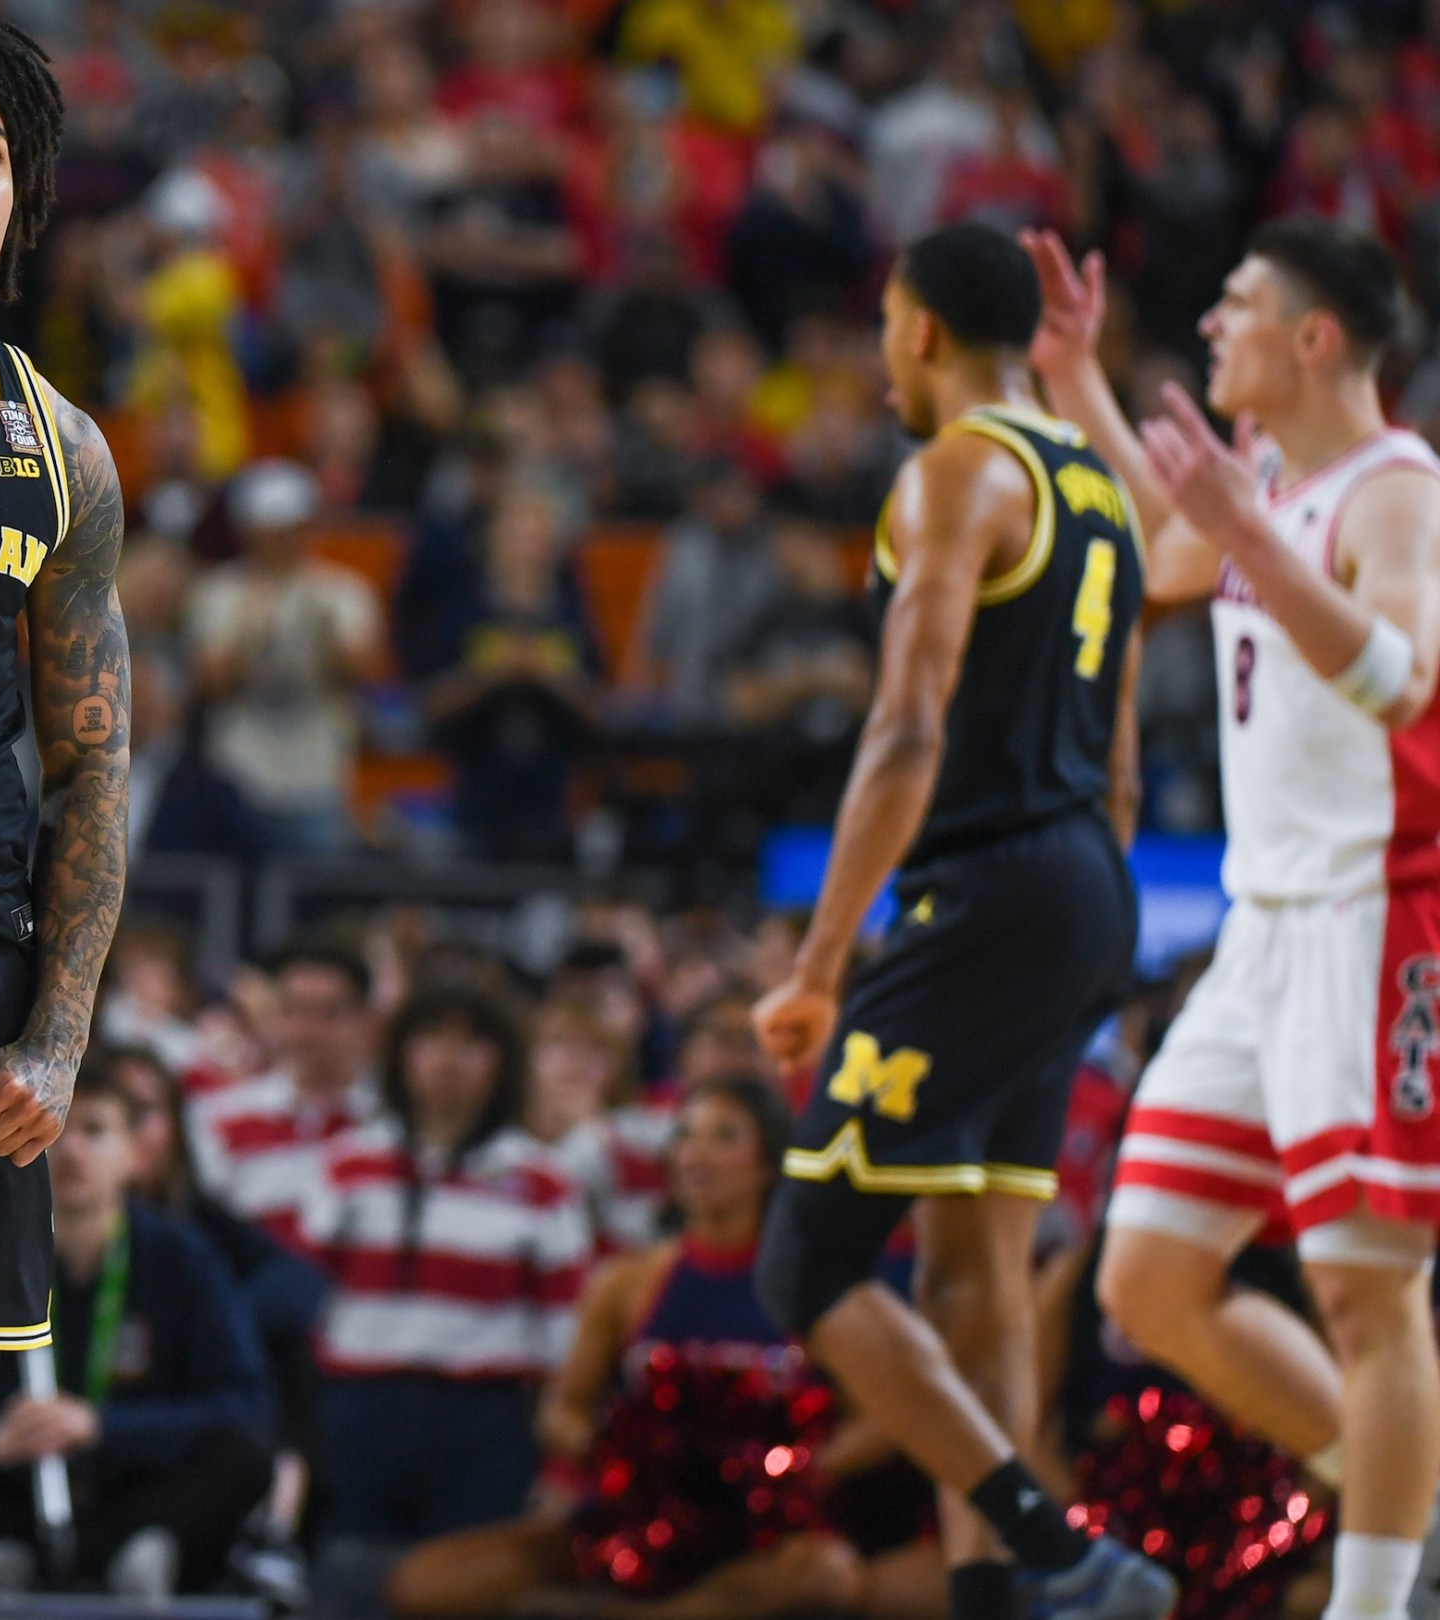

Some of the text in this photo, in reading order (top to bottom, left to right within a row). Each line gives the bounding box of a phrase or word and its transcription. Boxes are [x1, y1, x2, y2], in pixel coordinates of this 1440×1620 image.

[1, 410, 30, 424] FINAL
[10, 433, 37, 446] FOUR
[1072, 536, 1116, 681] 4
[827, 1030, 932, 1123] M
